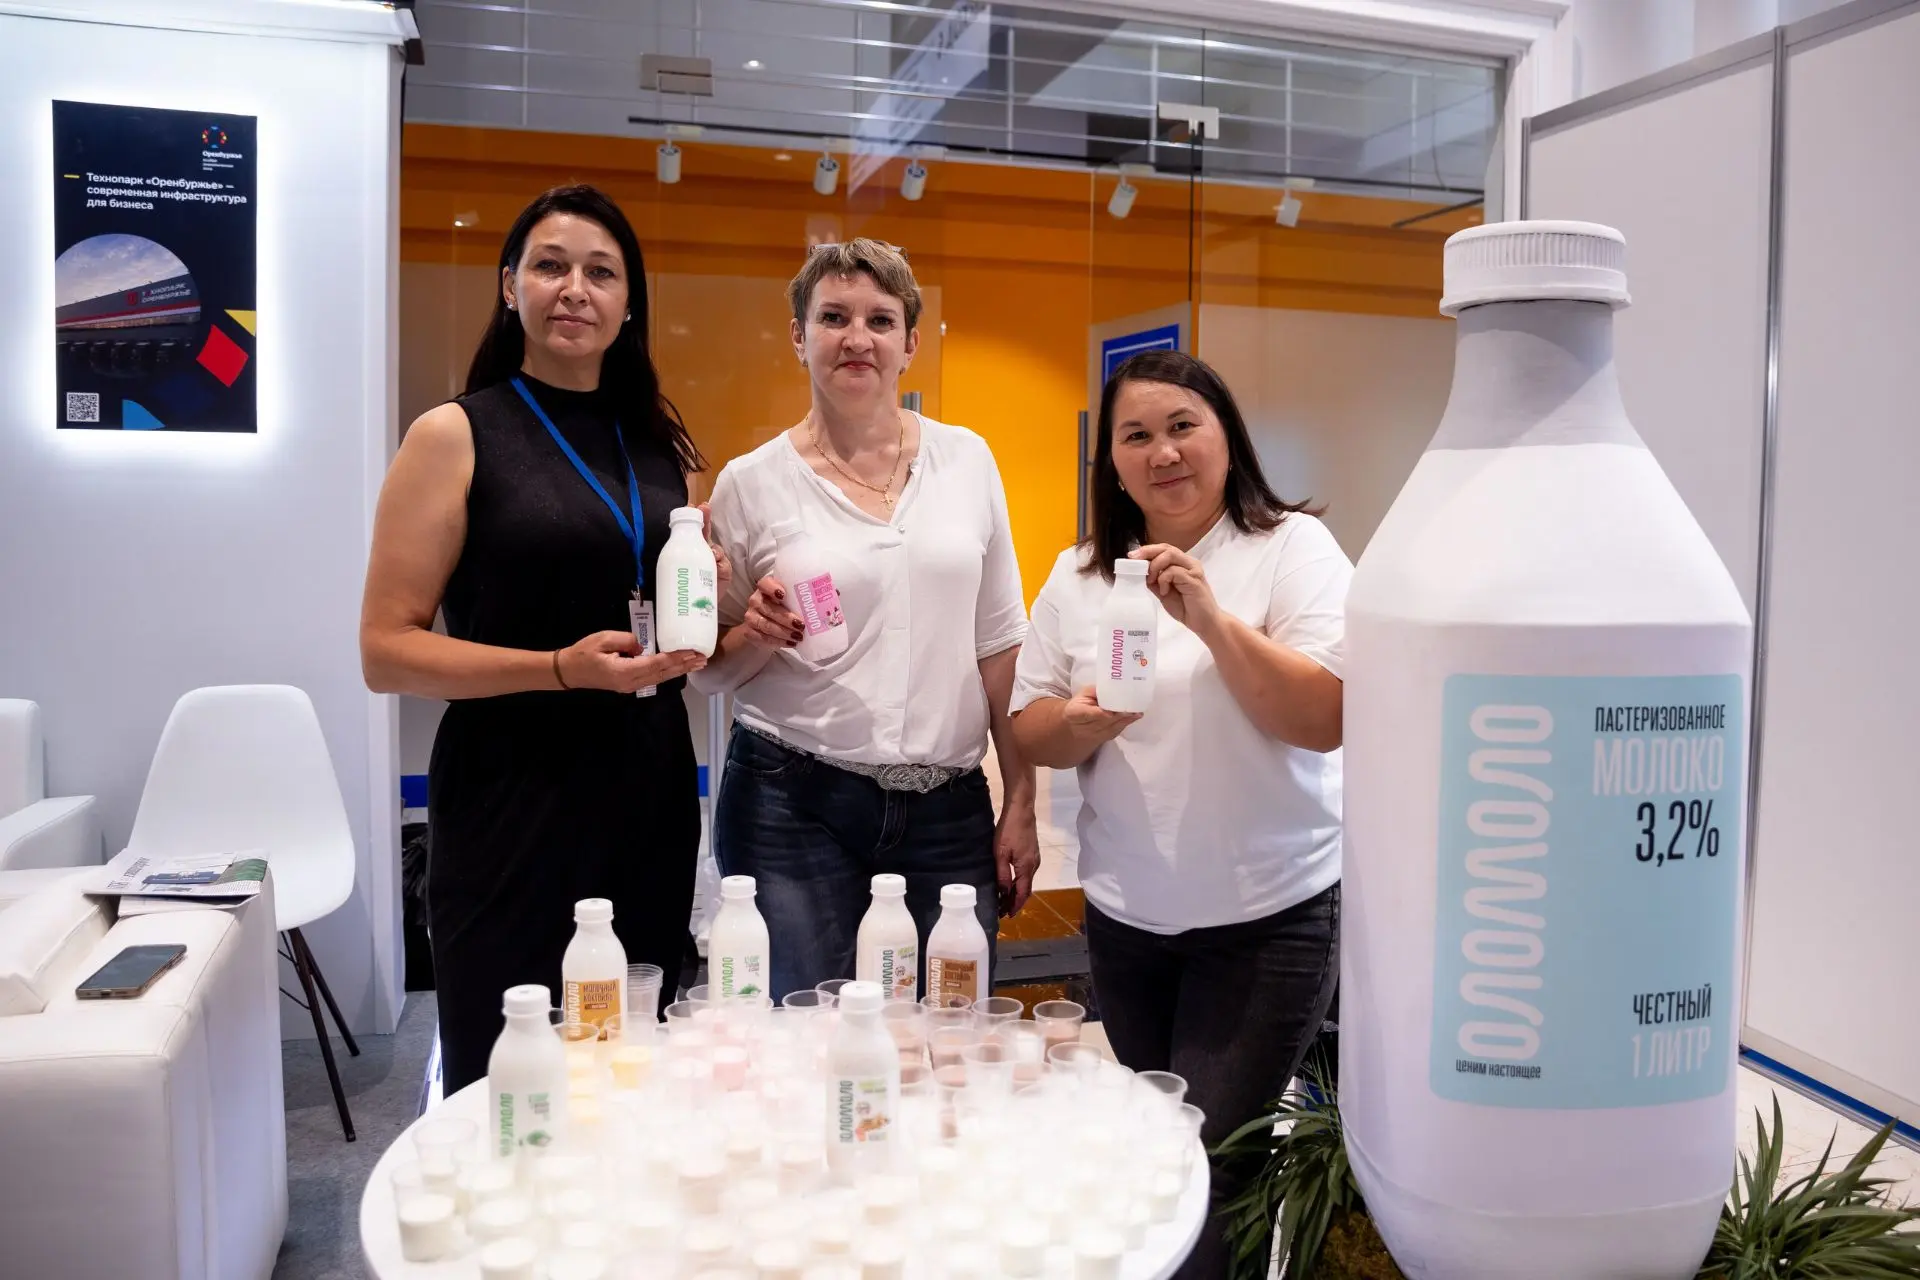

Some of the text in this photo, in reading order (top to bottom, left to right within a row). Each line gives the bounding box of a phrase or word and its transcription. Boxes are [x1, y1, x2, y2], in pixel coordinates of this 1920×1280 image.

[86, 172, 144, 185] Технопарк
[146, 177, 223, 190] «Оренбуржье»
[86, 186, 247, 205] современная инфраструктура
[86, 198, 154, 210] для бизнеса
[1595, 704, 1726, 733] ПАСТЕРИЗОВАННОЕ
[1592, 735, 1725, 797] МОЛОКО
[1635, 799, 1720, 867] 3,2%
[1458, 704, 1554, 1060] ОЛОМОЛО
[1632, 983, 1712, 1026] ЧЕСТНЫЙ
[1456, 1059, 1541, 1079] ценим настоящее
[1631, 1026, 1712, 1079] 1 ЛИТР
